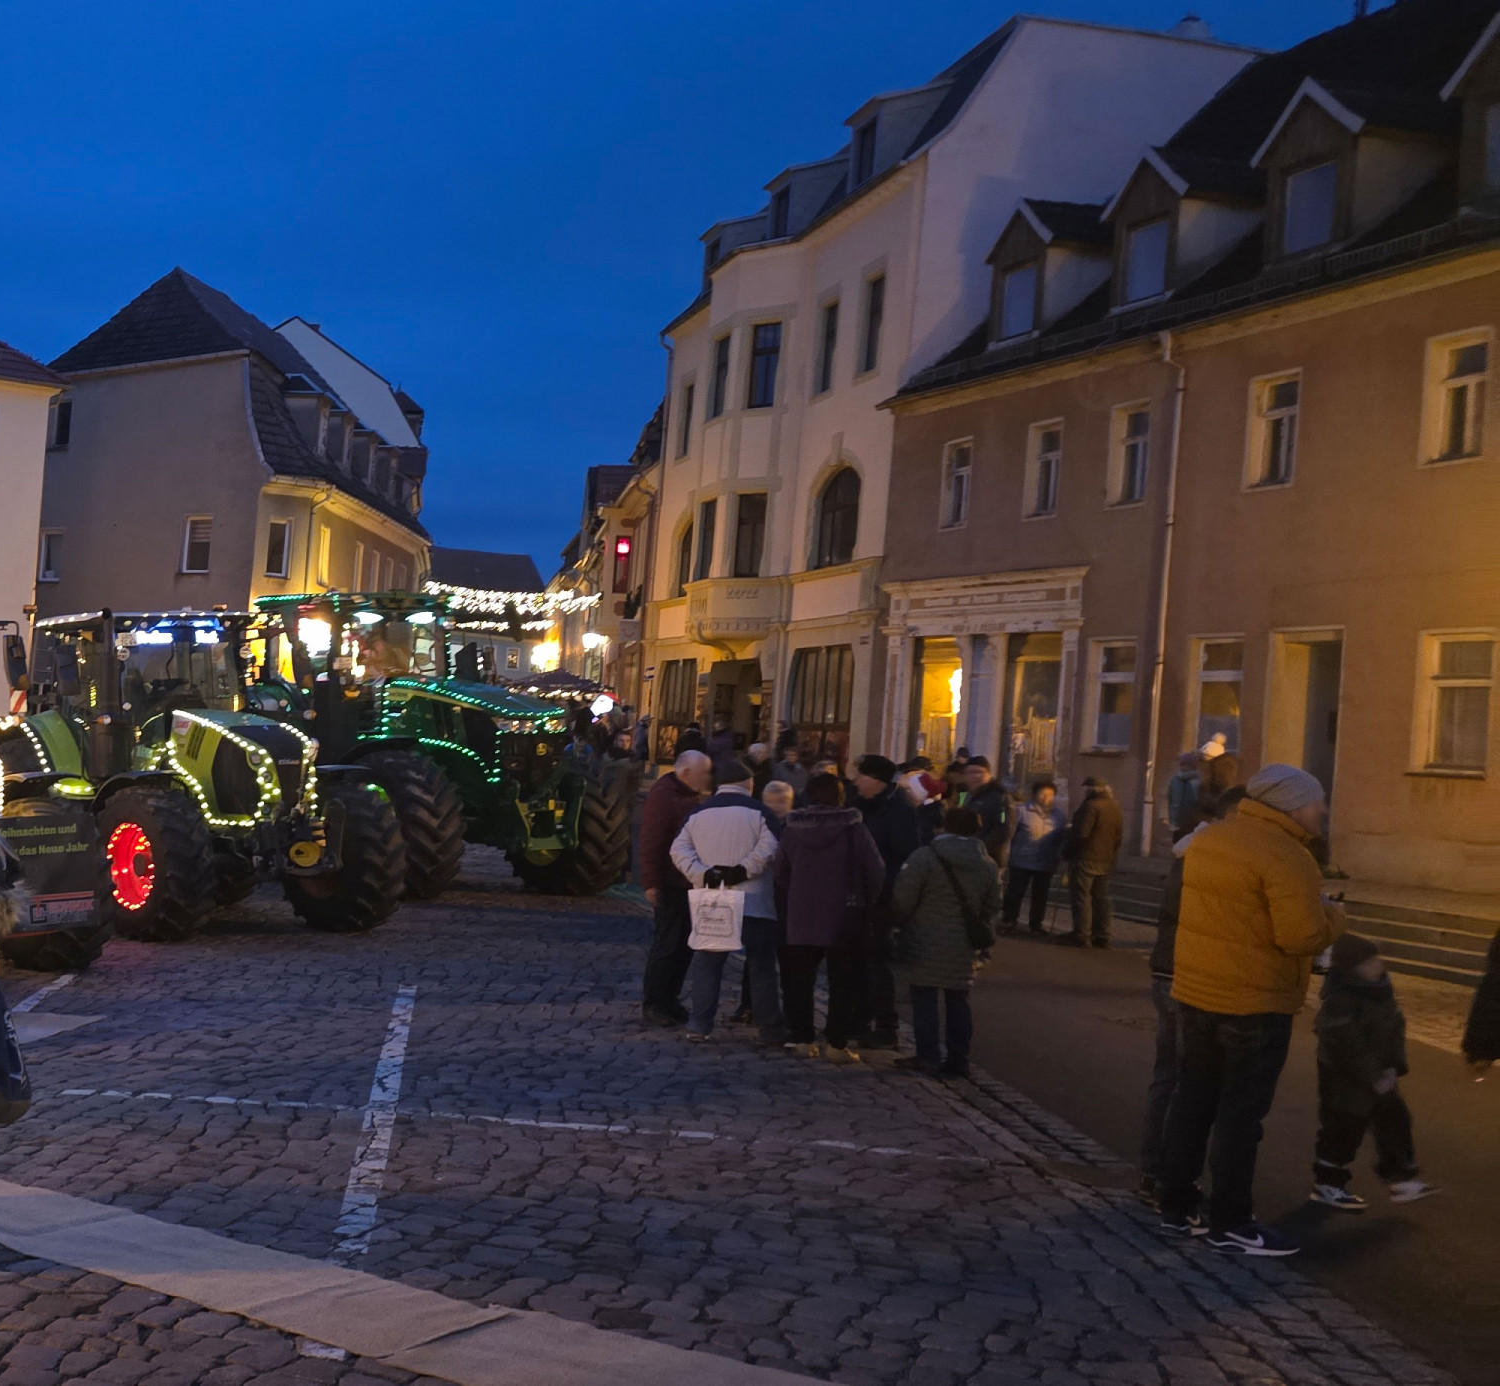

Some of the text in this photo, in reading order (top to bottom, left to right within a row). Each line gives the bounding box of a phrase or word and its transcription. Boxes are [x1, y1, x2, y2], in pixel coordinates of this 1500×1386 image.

[58, 823, 77, 834] und
[19, 845, 37, 856] das
[66, 840, 89, 852] Jahr
